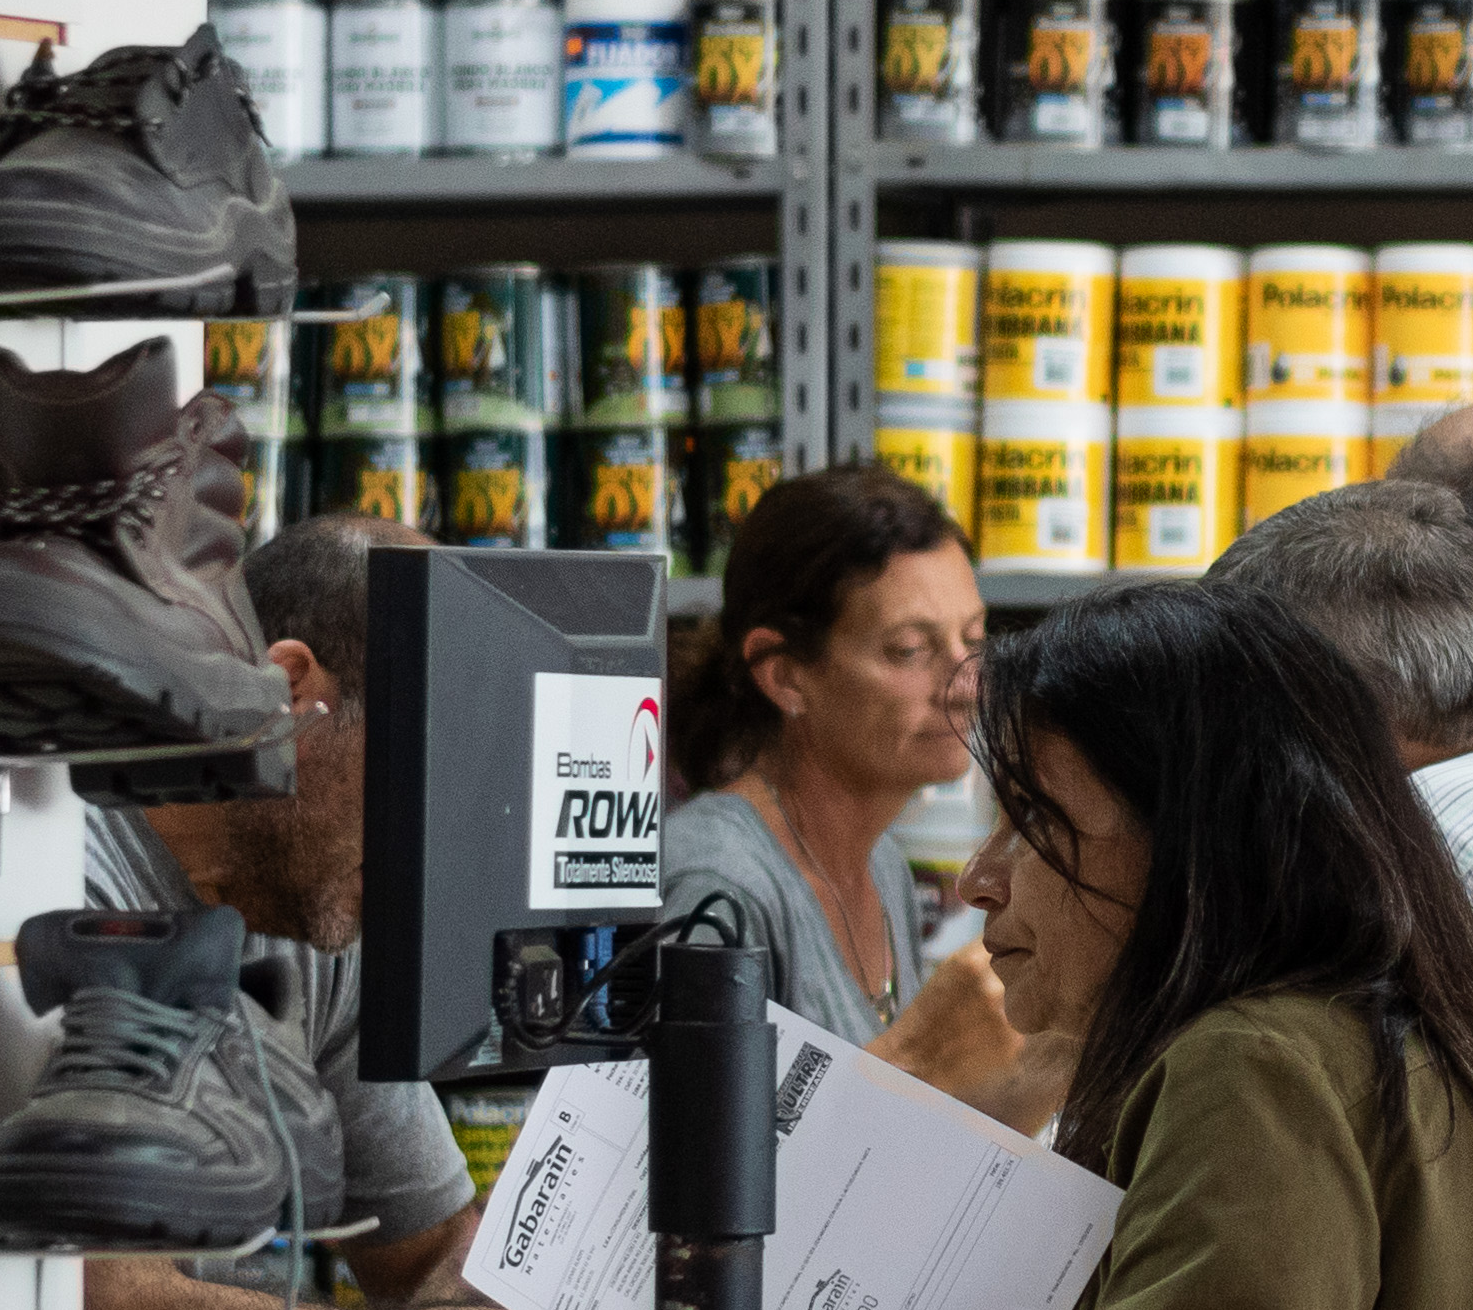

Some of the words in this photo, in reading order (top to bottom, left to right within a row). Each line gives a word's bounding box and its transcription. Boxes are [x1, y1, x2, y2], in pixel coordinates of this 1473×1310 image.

[557, 752, 612, 779] Bombas
[557, 856, 610, 883] Totalmente
[559, 1110, 571, 1124] B
[504, 1145, 573, 1270] Gabarain
